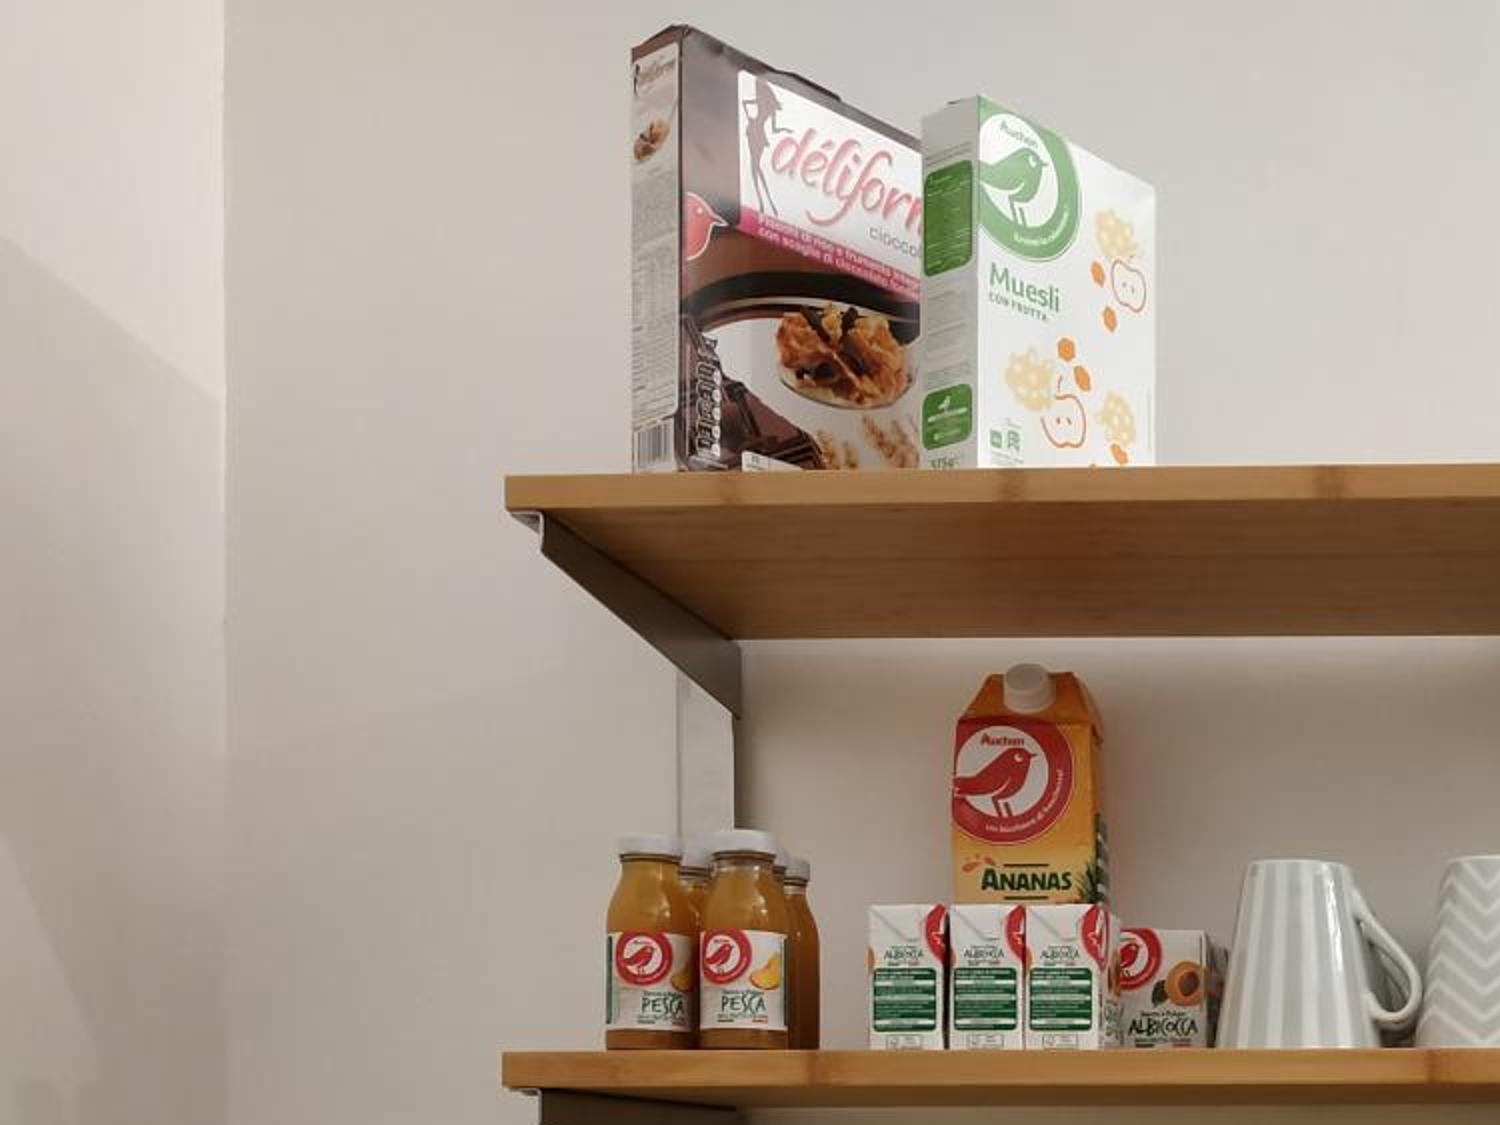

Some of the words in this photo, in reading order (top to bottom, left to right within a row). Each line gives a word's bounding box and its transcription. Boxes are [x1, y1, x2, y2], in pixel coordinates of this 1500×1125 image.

[989, 261, 1060, 313] Muesli
[981, 868, 1073, 891] ANANAS
[641, 996, 685, 1015] PESCA
[721, 996, 766, 1013] PESCA
[1128, 1018, 1199, 1036] ALBICOCCA
